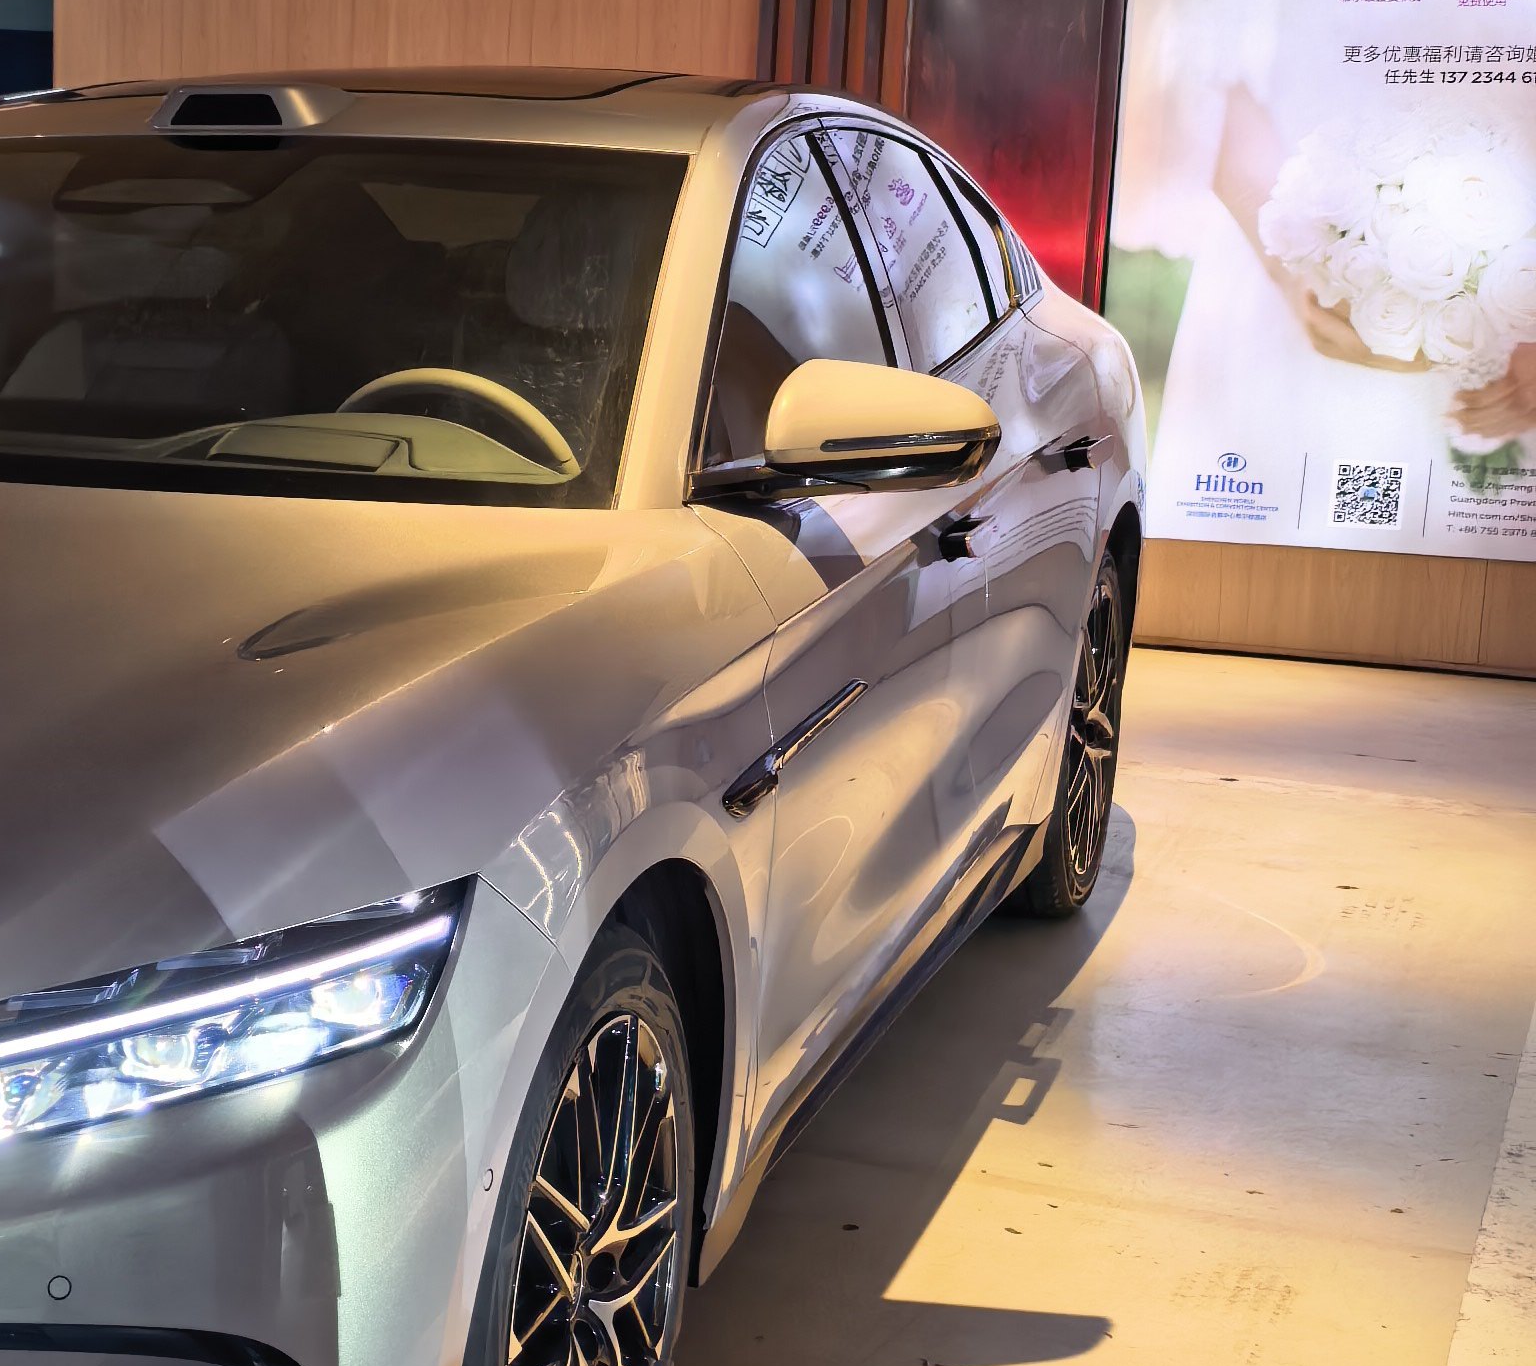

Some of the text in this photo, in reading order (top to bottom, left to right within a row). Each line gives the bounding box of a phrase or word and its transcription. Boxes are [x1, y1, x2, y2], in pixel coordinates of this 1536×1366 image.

[1384, 68, 1435, 85] 任先生
[1440, 71, 1468, 84] 137
[1471, 71, 1517, 84] 2344
[1195, 474, 1263, 494] Hilton
